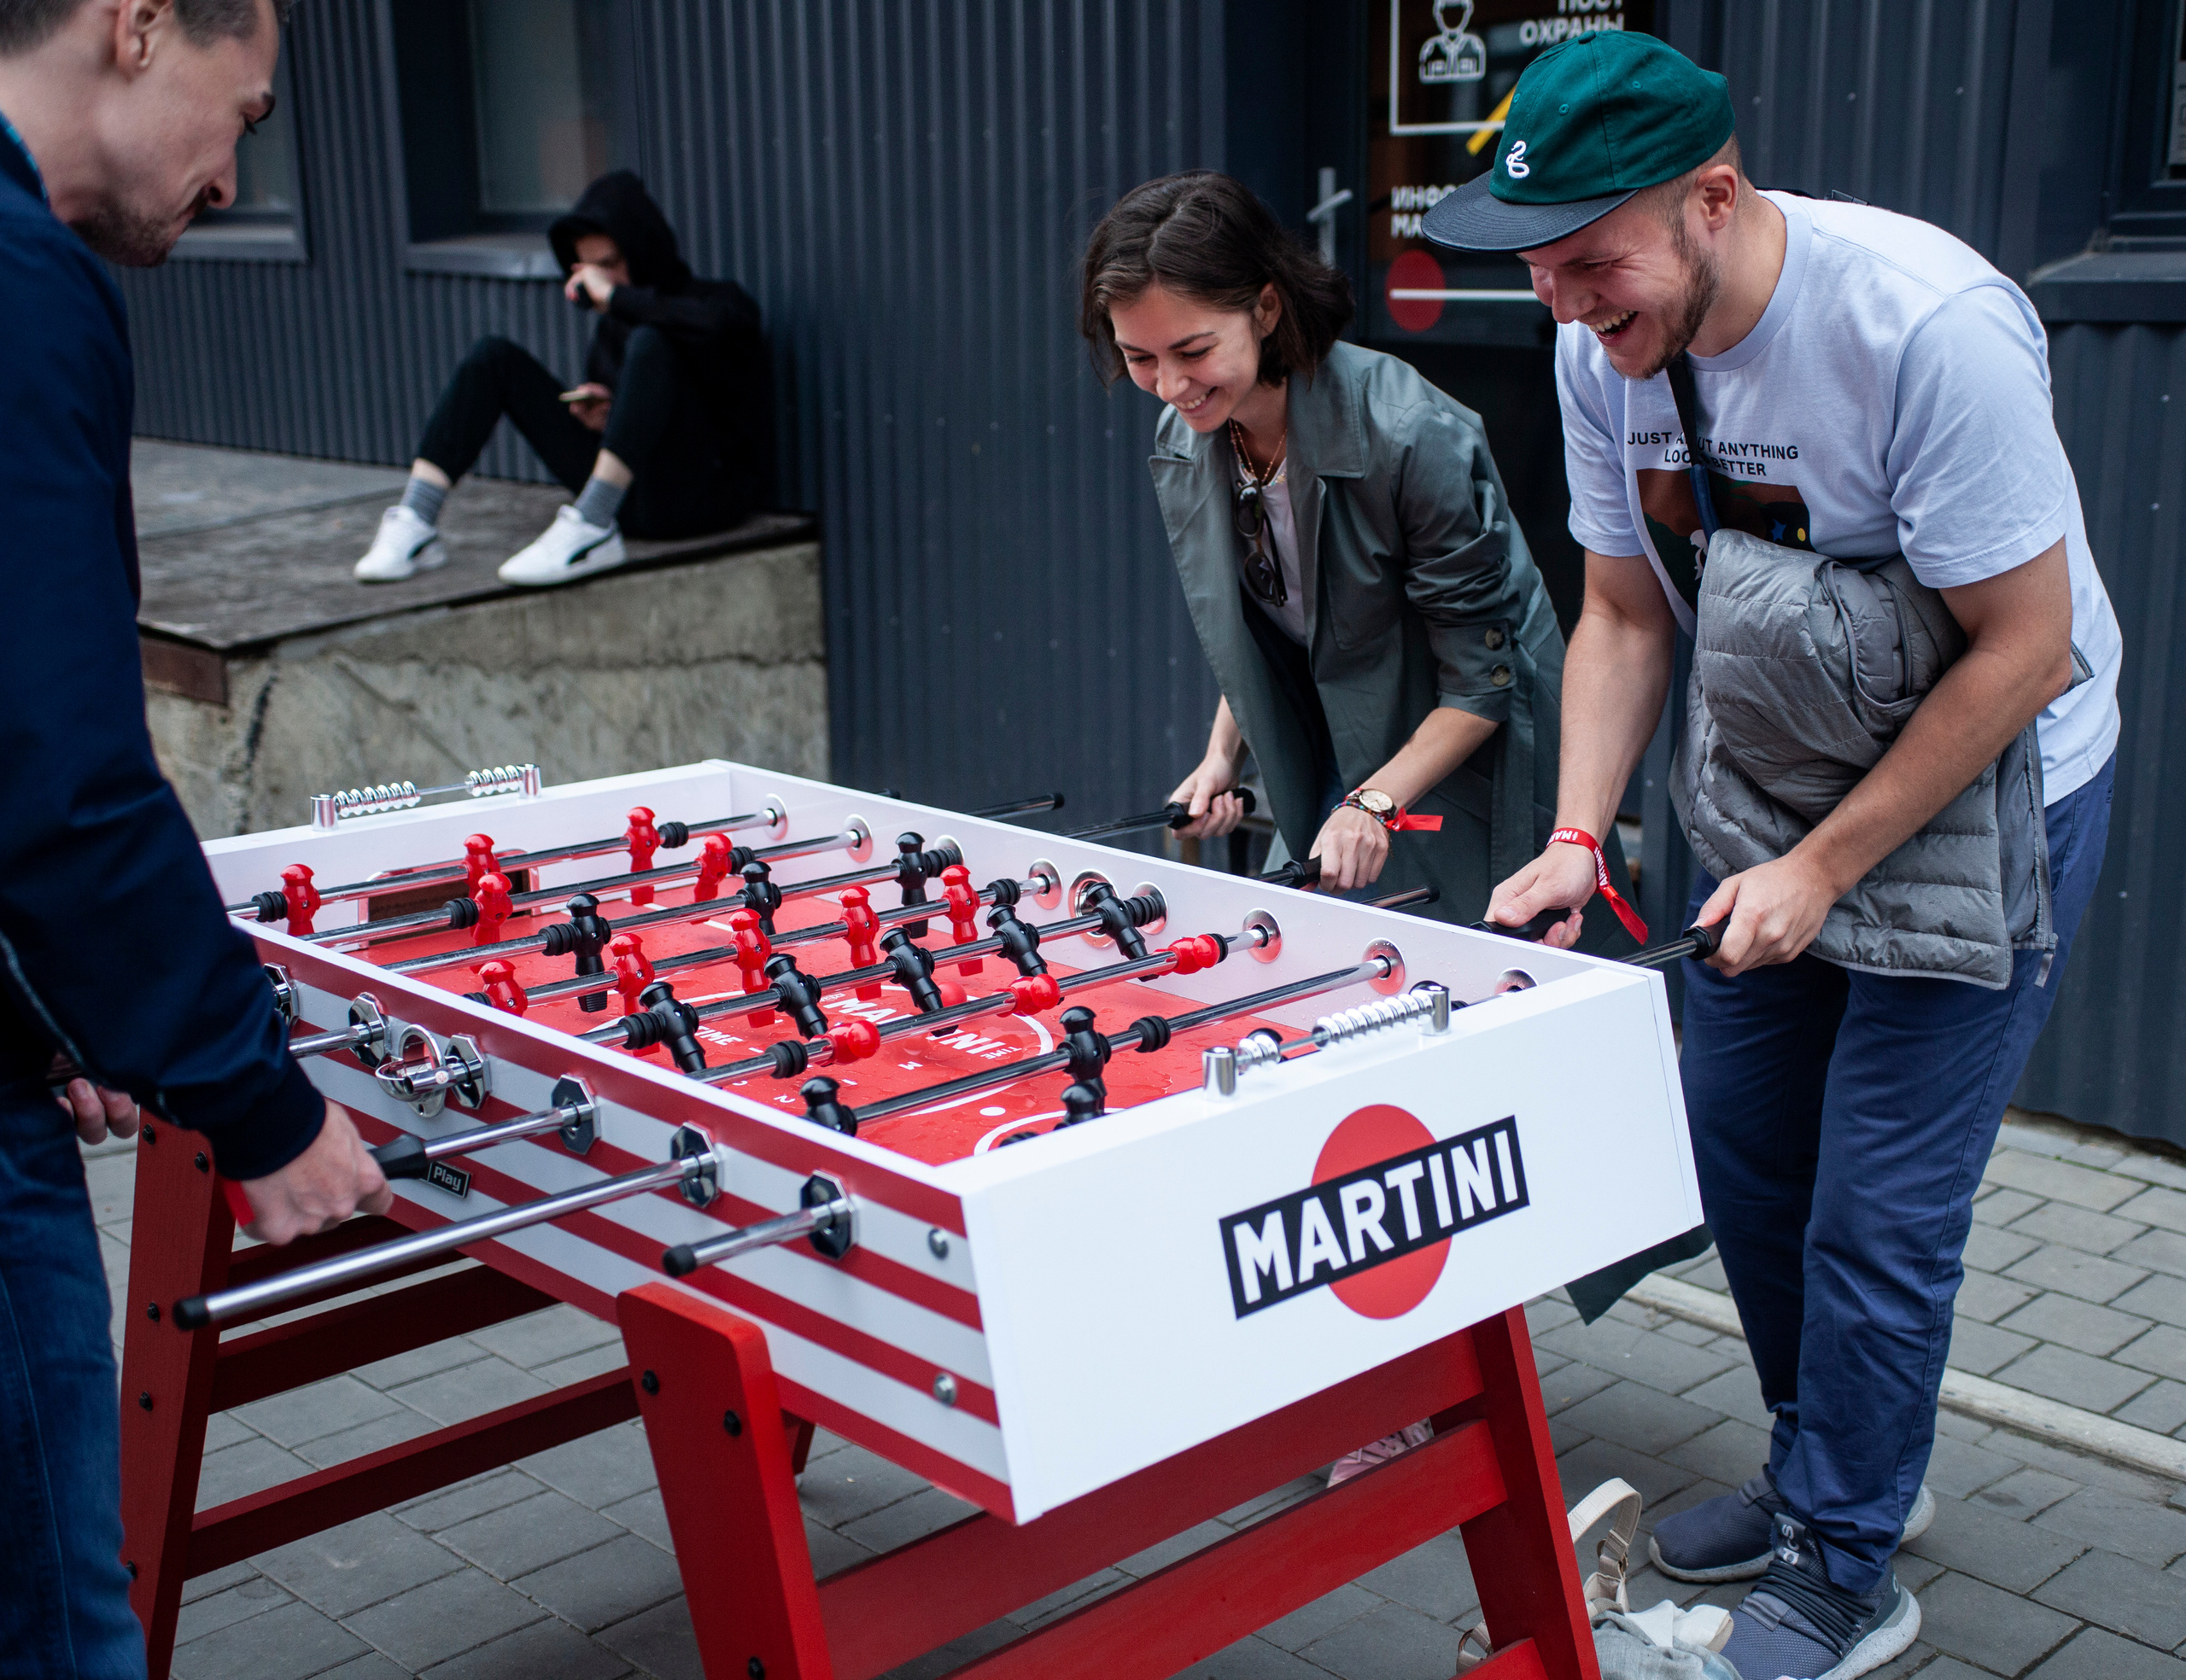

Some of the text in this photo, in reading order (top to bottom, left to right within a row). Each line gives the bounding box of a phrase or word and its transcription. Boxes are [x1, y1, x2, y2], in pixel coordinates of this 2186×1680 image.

[1520, 14, 1624, 46] ОХРАНЫ
[1392, 184, 1465, 209] ИНФ
[1392, 213, 1425, 237] МА
[1628, 432, 1798, 459] JUST AUT ANYTHING
[1664, 449, 1767, 475] LOO BETTER
[823, 998, 1005, 1054] MAINI
[433, 1165, 461, 1192] Play
[1233, 1129, 1518, 1304] MARTINI
